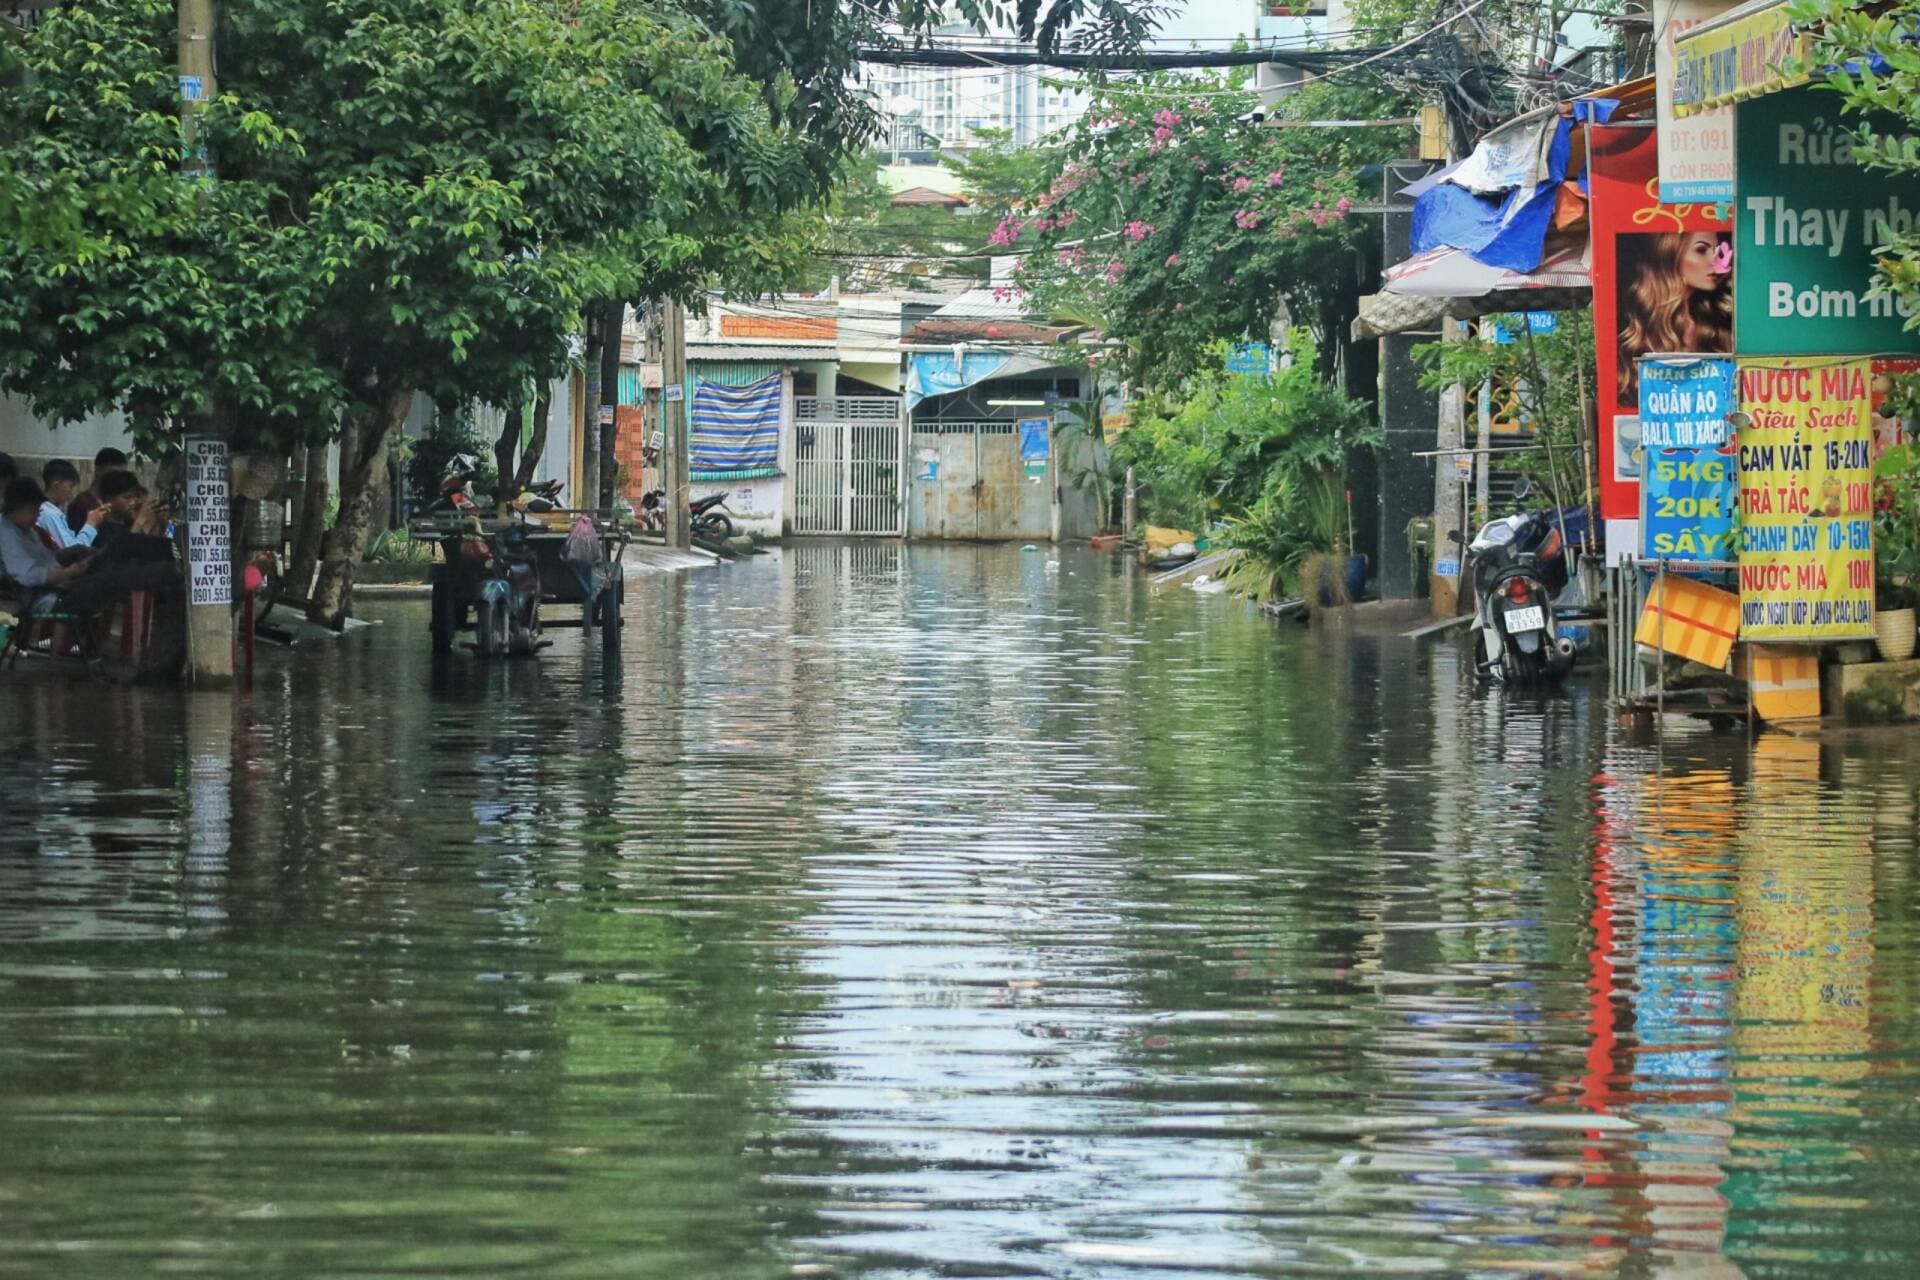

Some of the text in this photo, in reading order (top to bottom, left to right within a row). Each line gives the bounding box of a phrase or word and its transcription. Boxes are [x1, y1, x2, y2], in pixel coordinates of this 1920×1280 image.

[1701, 129, 1729, 151] 091
[1779, 116, 1856, 165] Rửa
[1747, 196, 1849, 257] Thay
[1863, 196, 1920, 245] nh
[1769, 282, 1856, 317] Bơm
[1740, 360, 1812, 404] NƯỚC
[1648, 383, 1717, 415] QUẦN ÁO
[1642, 415, 1725, 446] BALO, TÚI XÁCH
[1750, 406, 1858, 433] Siêu Sạch
[198, 443, 224, 455] CHO
[1740, 431, 1870, 472] CAM VẮT 15-20K
[1656, 461, 1725, 482] 5KG
[189, 496, 208, 506] VAY
[197, 484, 224, 496] CHO
[1741, 481, 1773, 515] TRÀ
[1777, 474, 1810, 514] TẮC
[1845, 482, 1871, 513] 10K
[1654, 496, 1721, 518] 20K
[191, 536, 211, 546] VAY
[200, 524, 226, 536] CHO
[1654, 526, 1721, 554] SẤY
[1743, 518, 1872, 553] CHANH DÂY 10-15K
[194, 576, 215, 586] VAY
[204, 564, 229, 576] CHO
[1741, 557, 1872, 592] NƯỚC MÍA 10K
